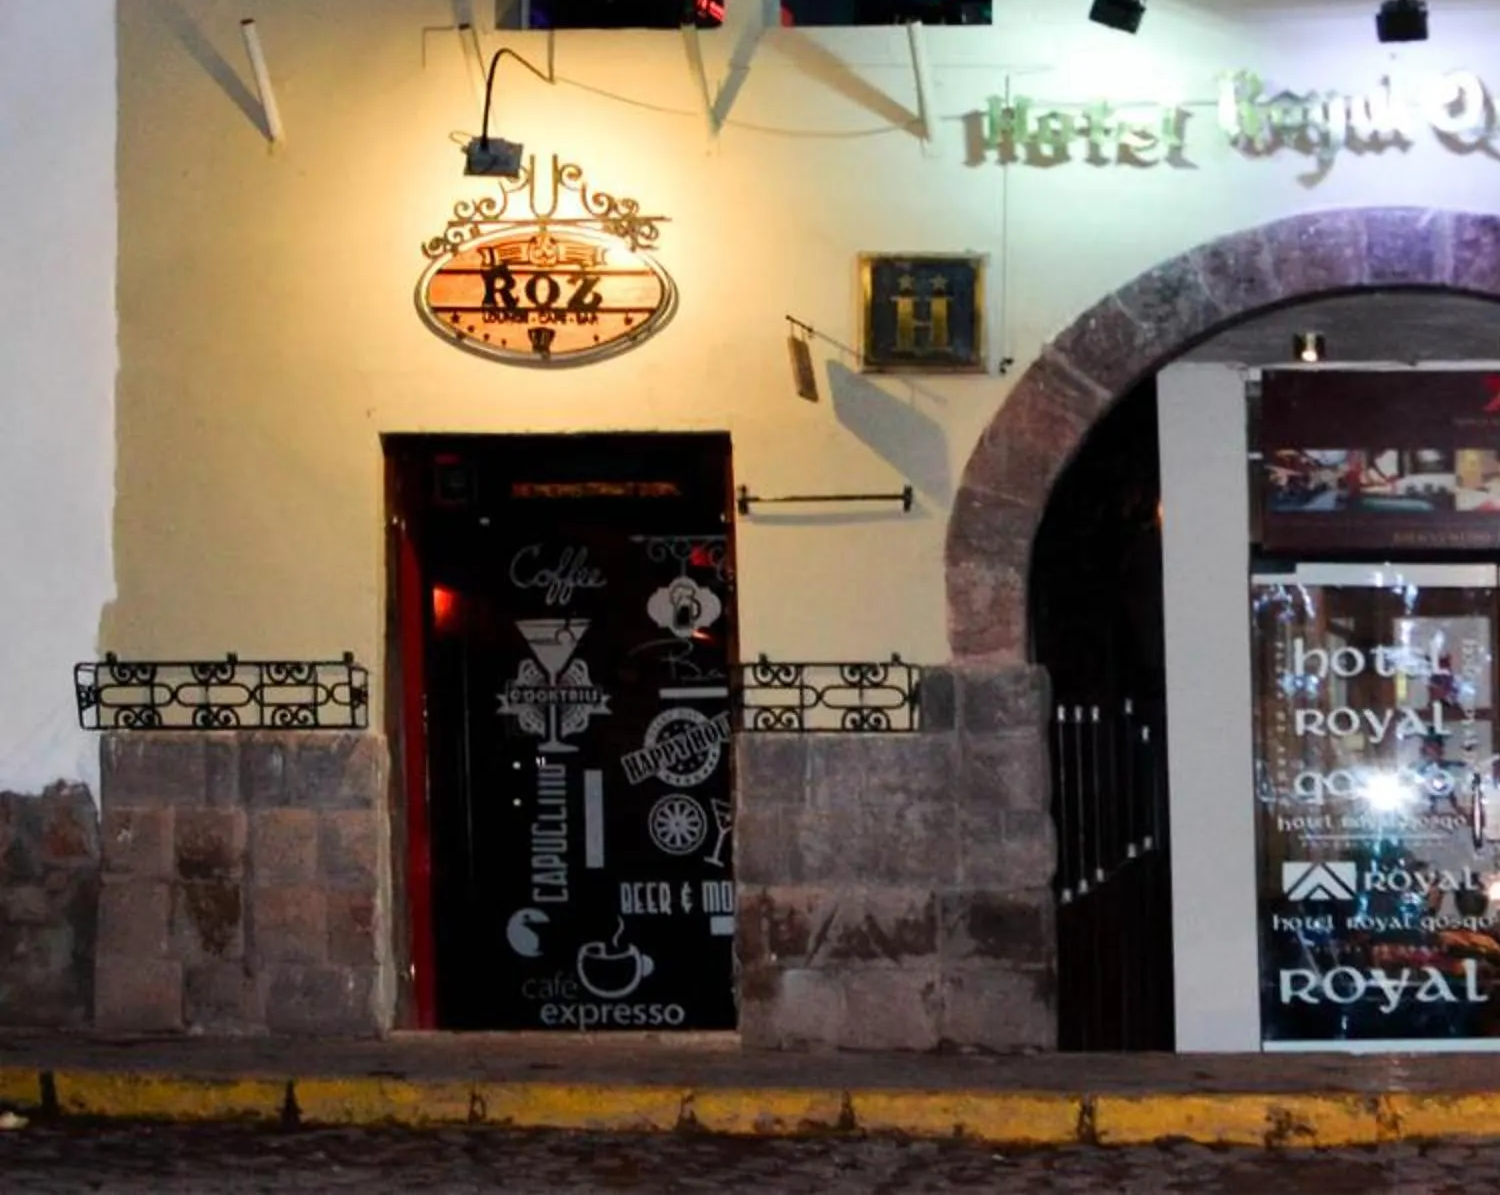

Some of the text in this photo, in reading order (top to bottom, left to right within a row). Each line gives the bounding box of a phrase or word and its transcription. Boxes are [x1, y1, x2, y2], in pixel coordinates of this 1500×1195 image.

[962, 91, 1196, 168] Hotel
[509, 544, 608, 605] Coffee
[622, 730, 694, 782] HAPPY
[1293, 767, 1454, 806] qoo
[619, 881, 673, 916] BEER
[540, 1003, 686, 1031] expresso
